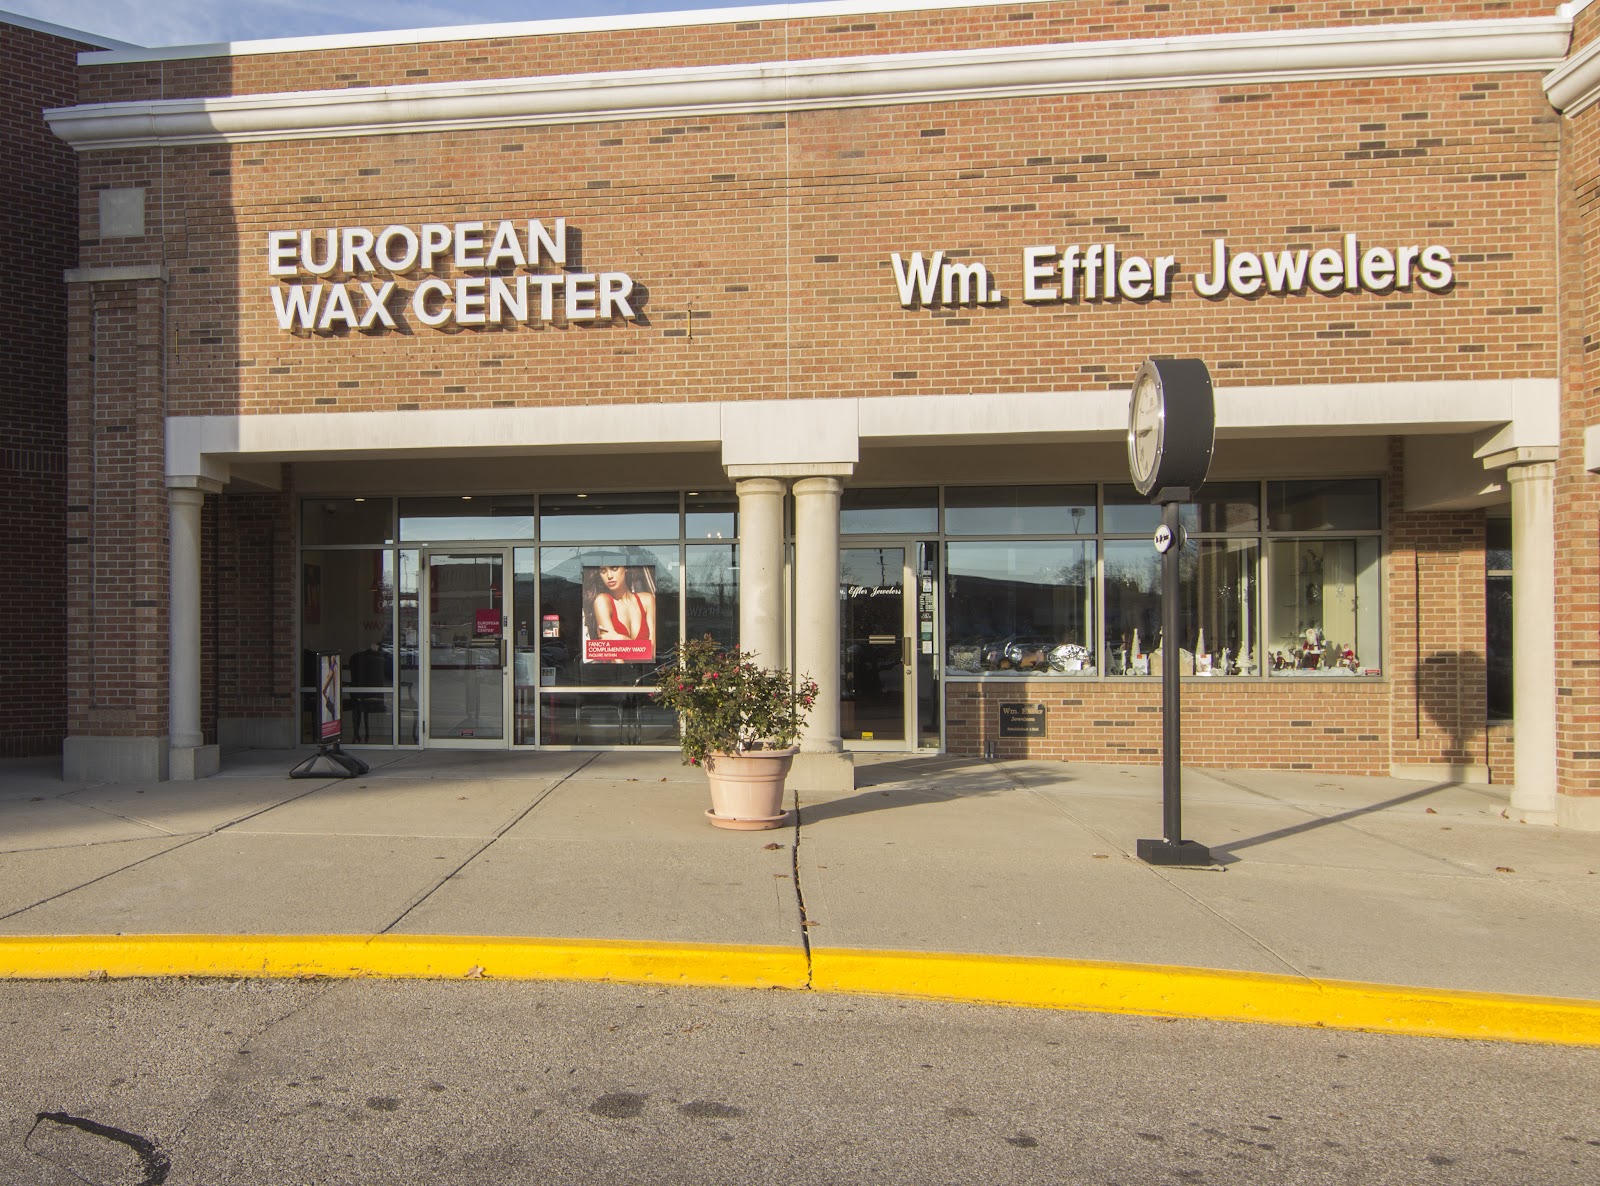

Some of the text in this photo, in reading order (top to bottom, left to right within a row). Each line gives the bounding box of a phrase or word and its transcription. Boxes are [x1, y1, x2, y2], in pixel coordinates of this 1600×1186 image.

[268, 217, 567, 276] EUROPEAN
[890, 233, 1455, 307] Wm. Effler Jewelers
[269, 271, 637, 331] WAX CENTER
[848, 585, 868, 598] Effler
[870, 585, 902, 598] Jewelers
